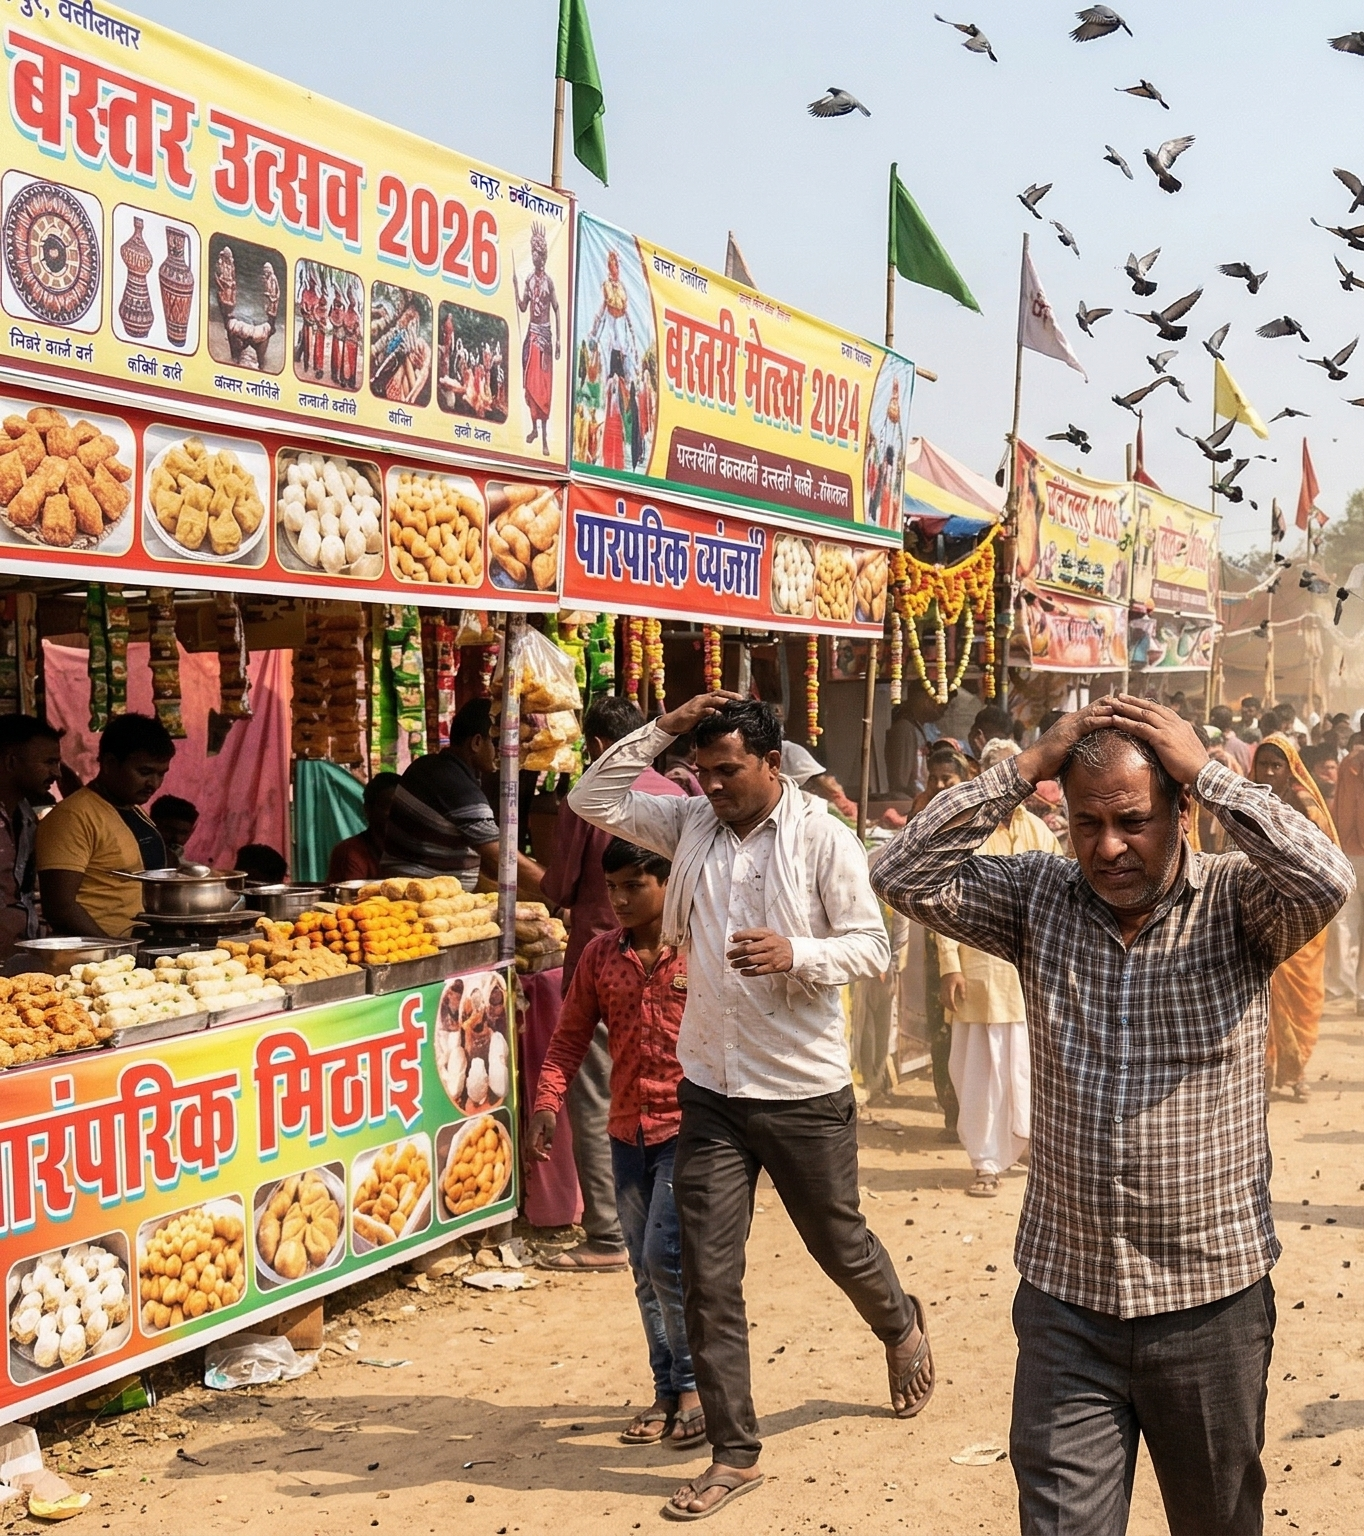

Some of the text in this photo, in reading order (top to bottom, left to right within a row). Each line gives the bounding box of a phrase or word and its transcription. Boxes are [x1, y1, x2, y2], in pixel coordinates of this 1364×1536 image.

[9, 30, 499, 286] बस्तर उत्सव 2026
[665, 308, 739, 406] बस्तरी
[811, 368, 859, 443] 2024
[575, 501, 690, 586] पारंपरिक
[0, 995, 425, 1228] ारंपरिक मिठाई
